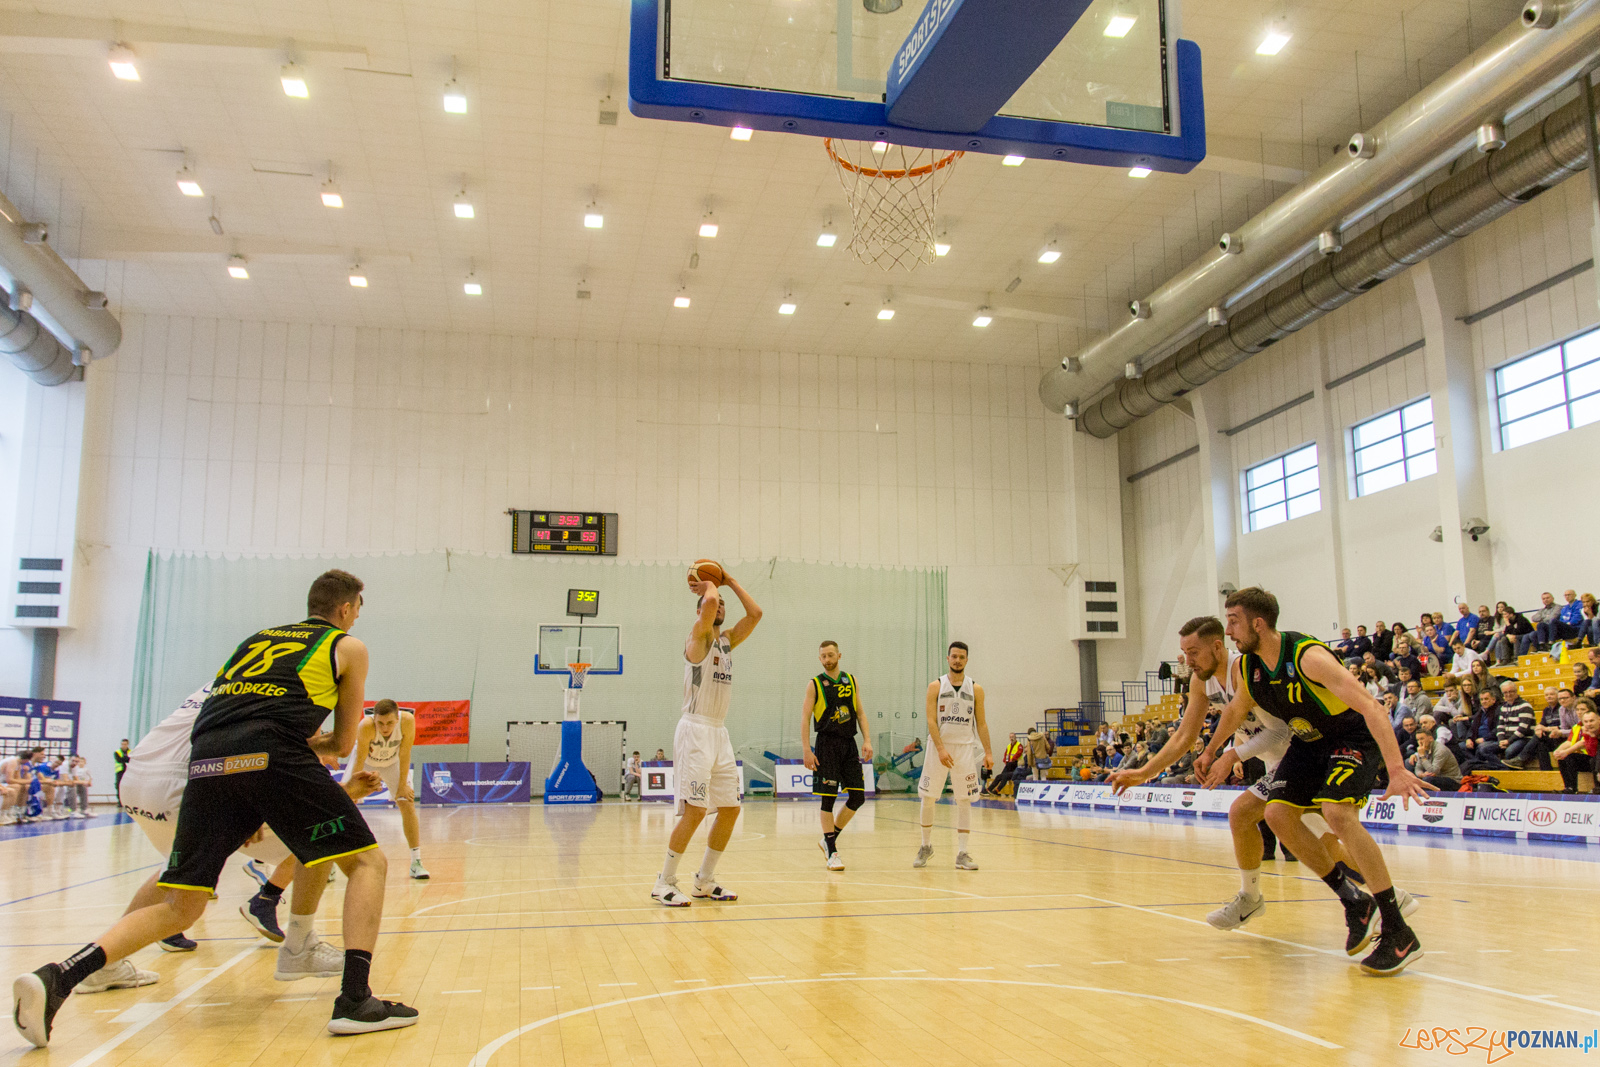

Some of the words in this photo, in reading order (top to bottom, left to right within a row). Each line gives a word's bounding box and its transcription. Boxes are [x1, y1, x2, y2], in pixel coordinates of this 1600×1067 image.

[587, 516, 593, 524] 2
[537, 530, 551, 541] 47
[562, 530, 569, 540] 3
[582, 531, 597, 542] 53
[258, 628, 314, 640] PABIANEK
[224, 640, 307, 681] 18
[837, 685, 852, 698] 25
[1286, 682, 1303, 704] 11
[952, 702, 960, 715] 6
[190, 761, 224, 775] TRANS
[1326, 766, 1355, 787] 11
[691, 781, 706, 797] 14
[1153, 792, 1173, 804] NICKEL
[1374, 802, 1396, 820] PBG
[1425, 806, 1444, 815] JOKER
[1479, 807, 1523, 822] NICKEL
[1532, 811, 1552, 823] KIA
[1563, 812, 1594, 825] DELIK
